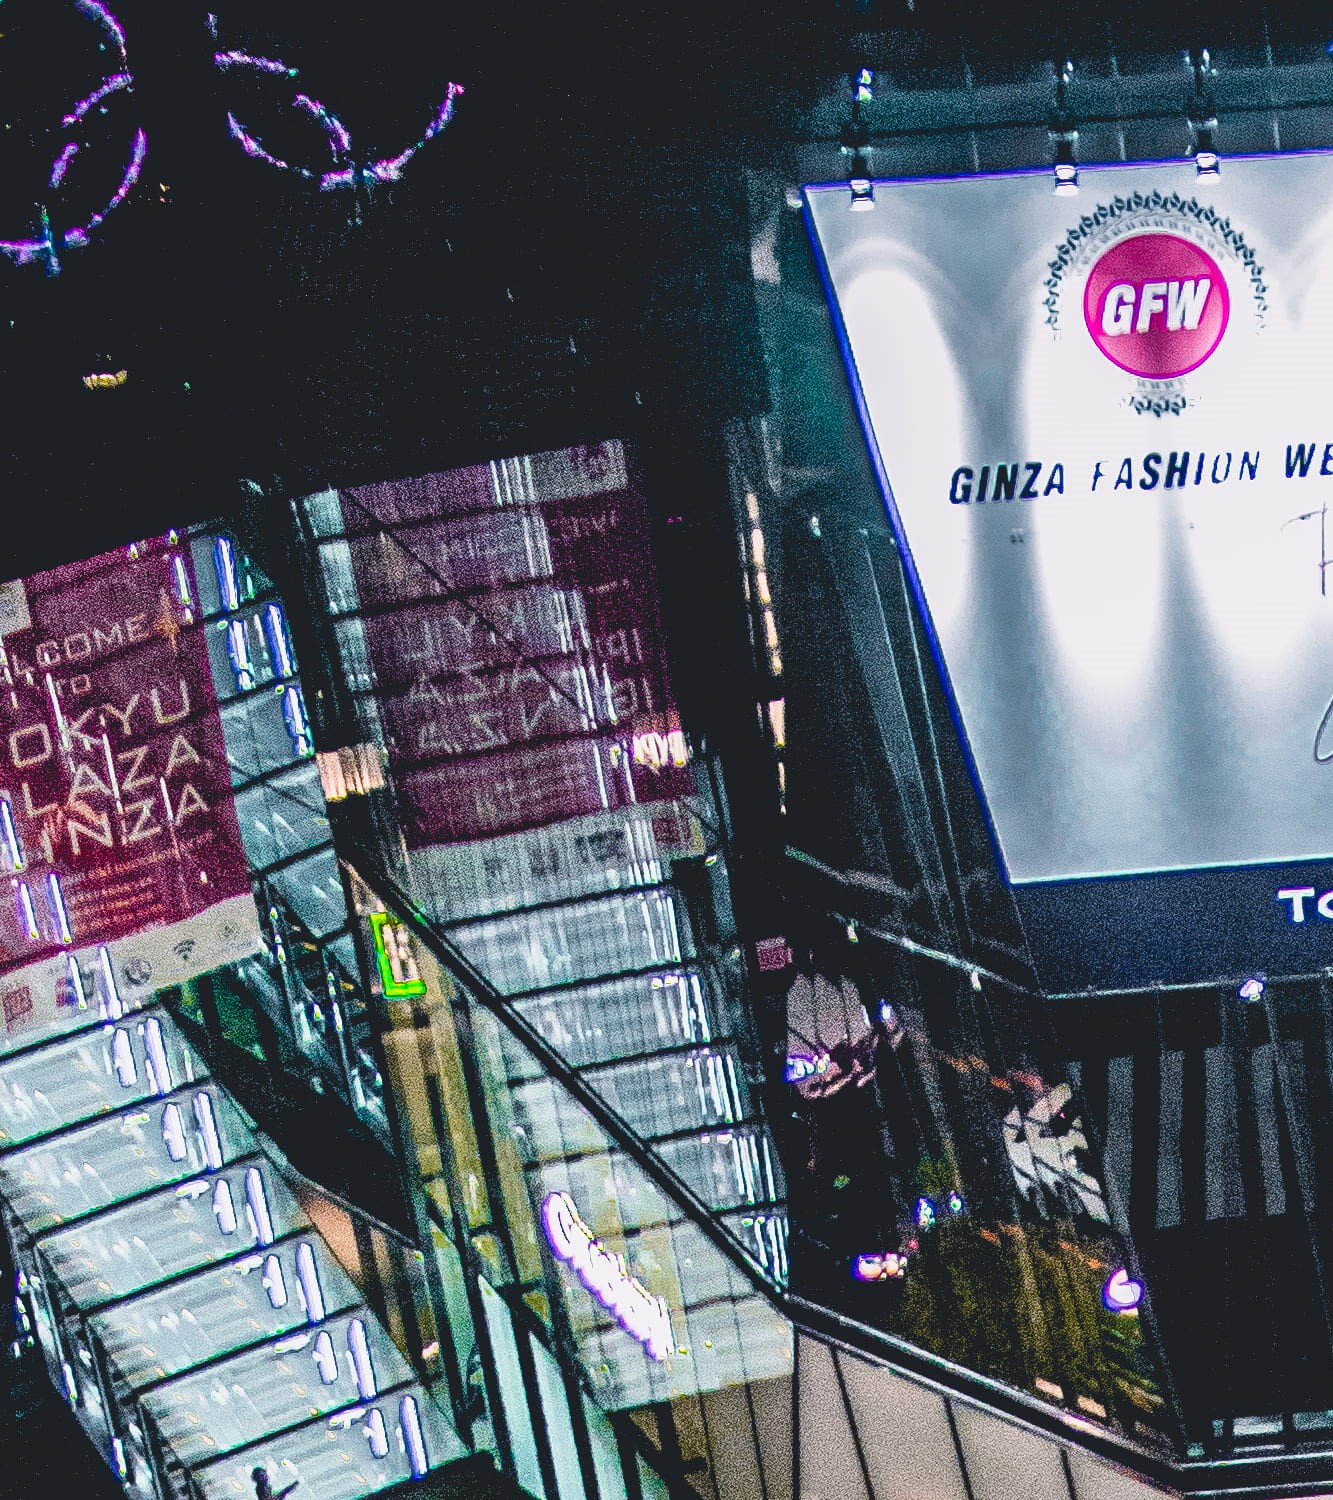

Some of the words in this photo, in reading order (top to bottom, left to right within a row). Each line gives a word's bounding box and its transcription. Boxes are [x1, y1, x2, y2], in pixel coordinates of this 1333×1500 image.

[1101, 278, 1211, 337] GFW
[950, 462, 1064, 504] GINZA
[1092, 450, 1260, 491] FASHION
[10, 679, 191, 769] OKYU
[22, 734, 201, 818] LAZA
[40, 782, 210, 865] INZA
